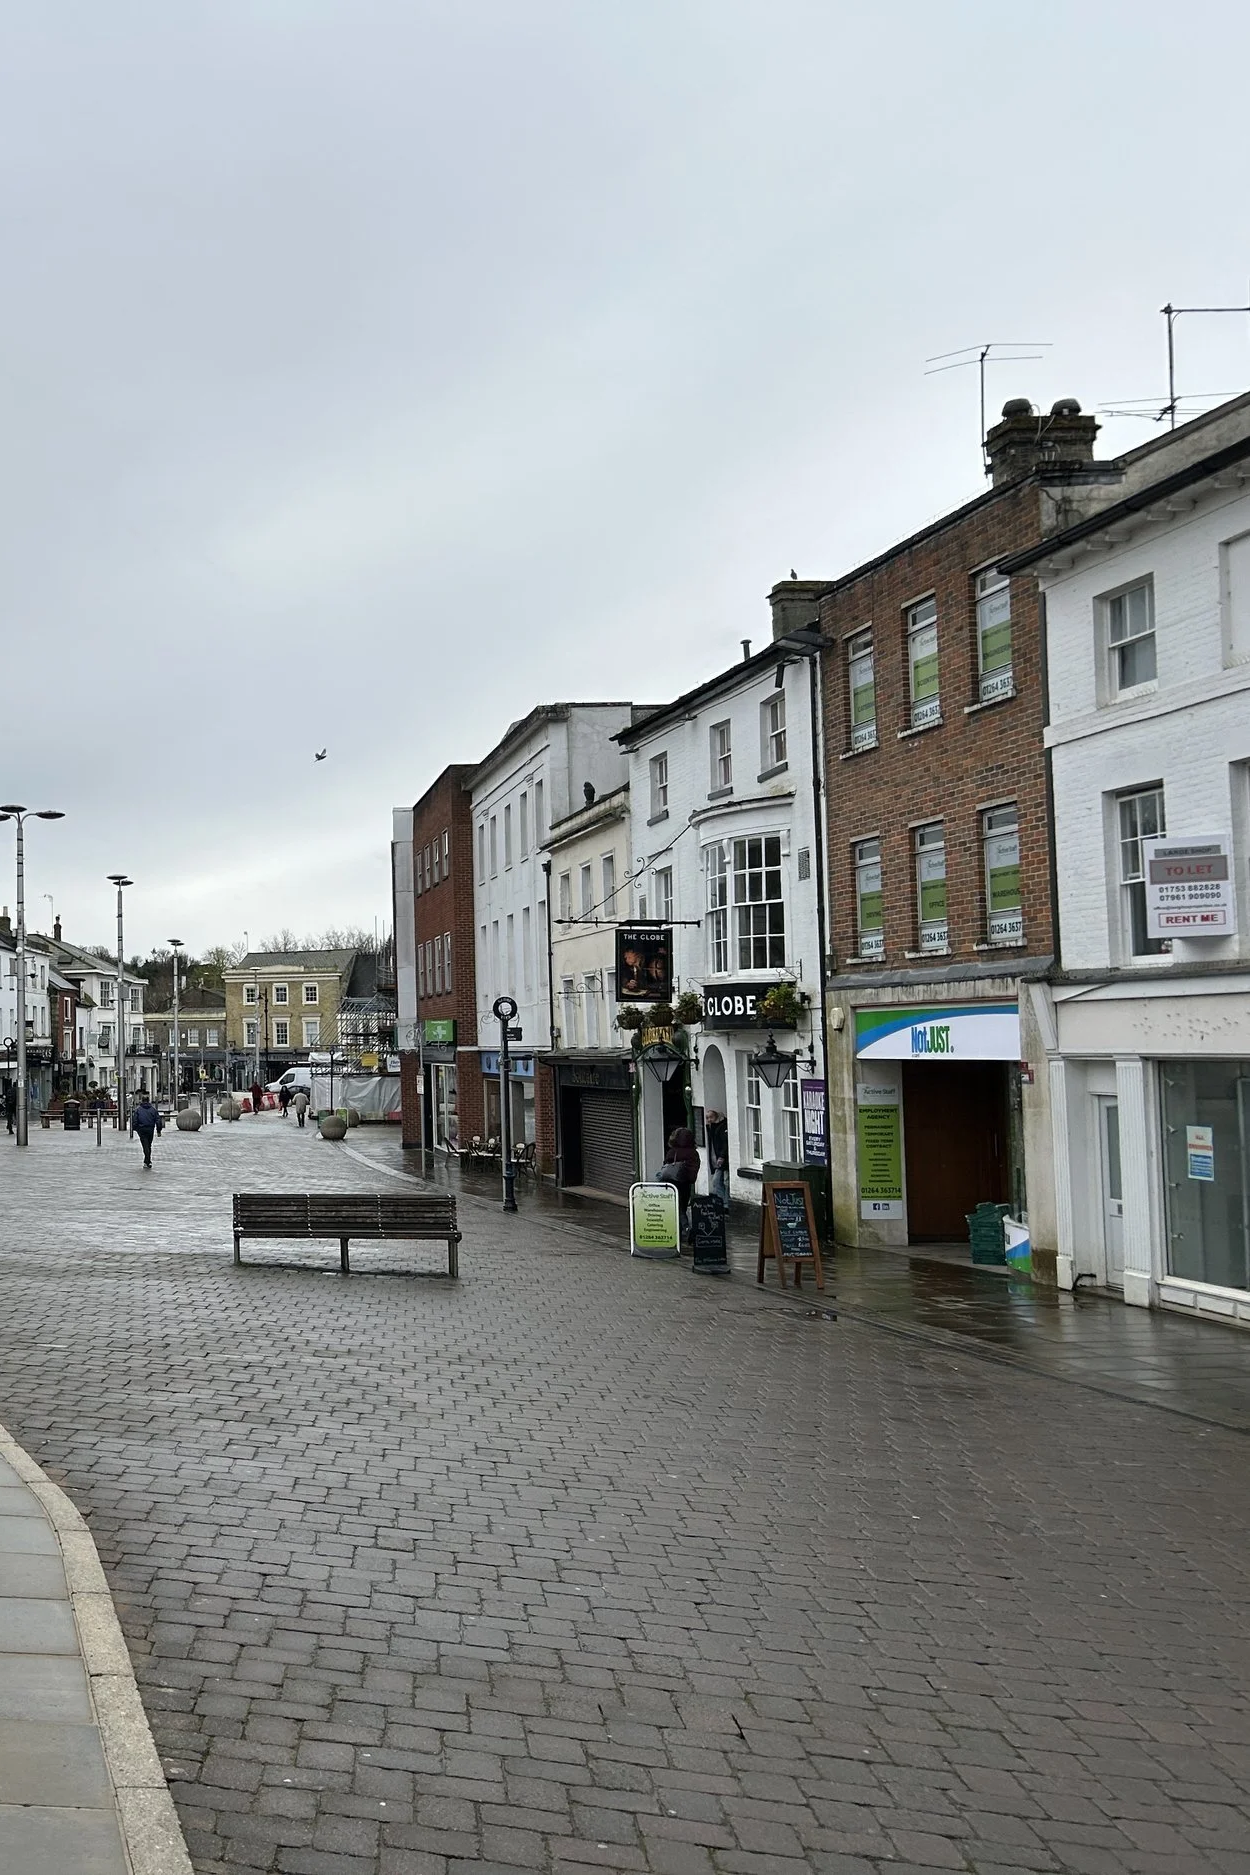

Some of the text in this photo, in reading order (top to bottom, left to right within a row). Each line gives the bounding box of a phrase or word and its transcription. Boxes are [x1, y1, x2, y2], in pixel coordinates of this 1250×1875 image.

[1165, 864, 1213, 876] TO LET
[992, 887, 1020, 898] WAREHOUS
[1158, 883, 1221, 893] 01753 882828
[1188, 892, 1221, 900] 909090
[1166, 914, 1219, 924] RENT ME
[991, 921, 1022, 935] 01264 3637
[922, 930, 948, 943] 01264 3637
[707, 995, 757, 1016] GLOBE
[803, 1090, 825, 1111] KARAOKE
[804, 1109, 824, 1135] NIGHT
